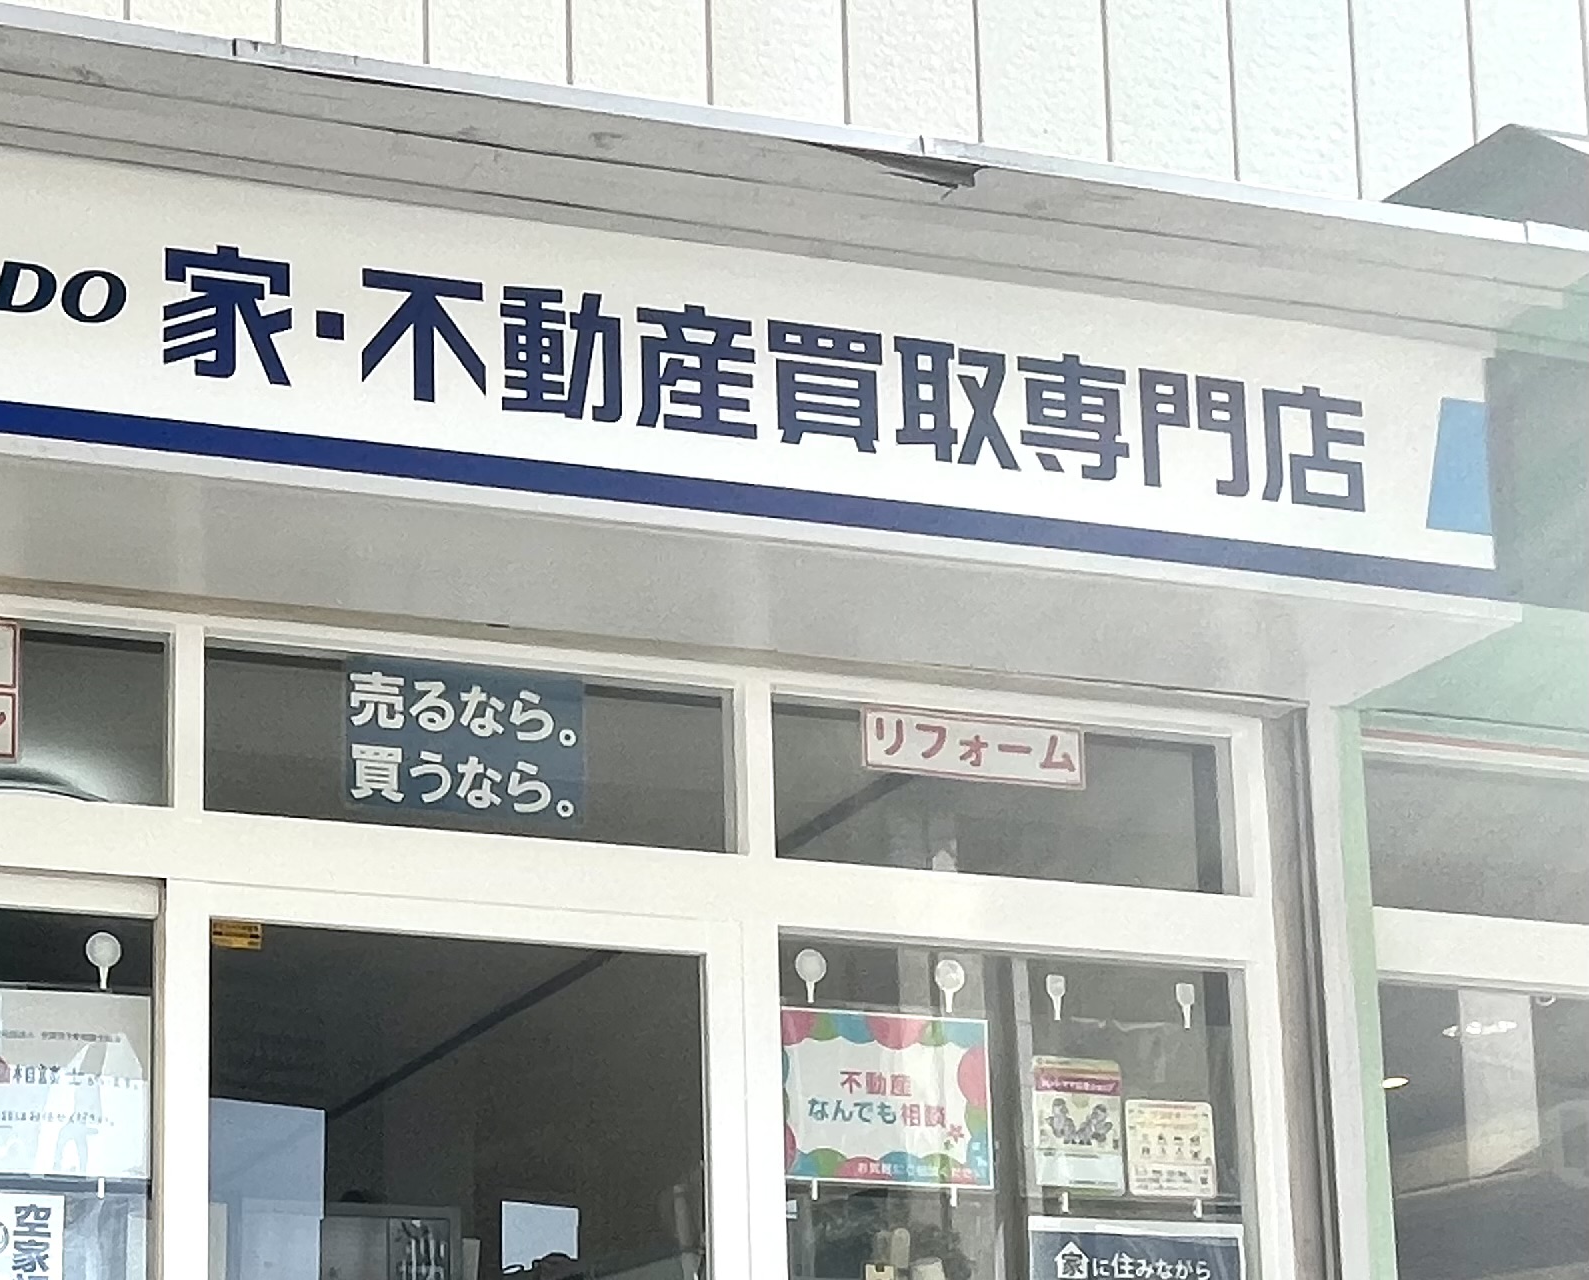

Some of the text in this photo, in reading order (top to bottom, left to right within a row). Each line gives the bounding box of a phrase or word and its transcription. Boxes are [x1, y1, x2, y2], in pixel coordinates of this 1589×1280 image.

[163, 245, 1367, 513] 家・不動産買取専門店
[349, 671, 577, 747] 売るなら。
[876, 717, 1075, 772] リフォーム
[350, 743, 575, 818] 買うなら。
[840, 1071, 912, 1097] 不動産
[808, 1098, 946, 1128] なんでも相談
[1056, 1249, 1211, 1280] 家に住みながら
